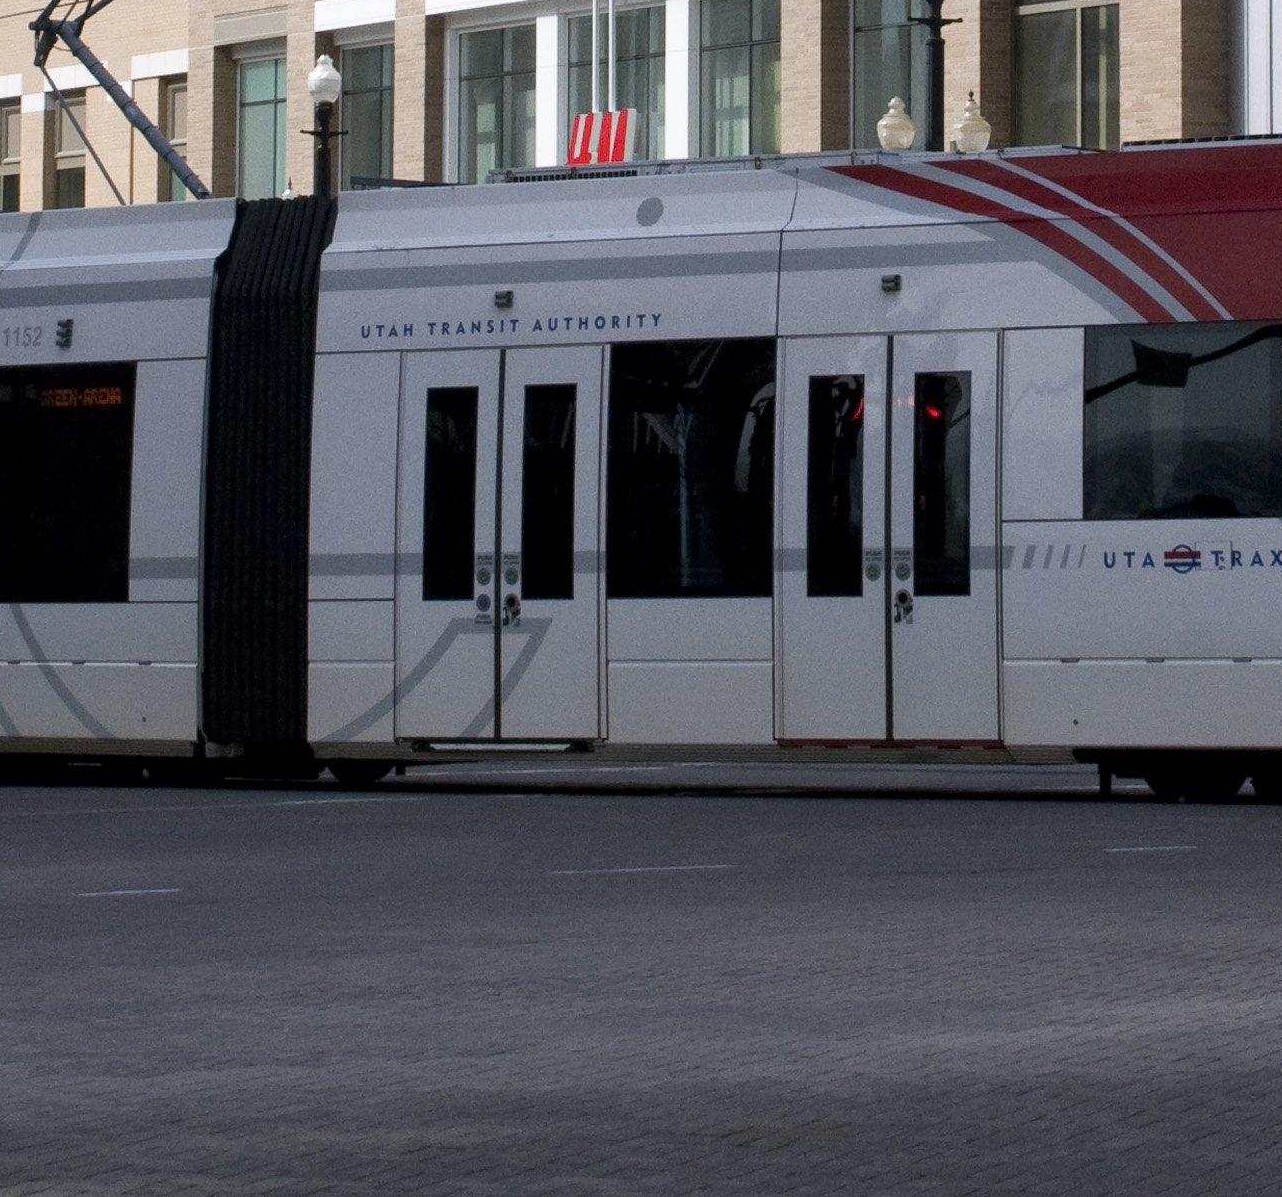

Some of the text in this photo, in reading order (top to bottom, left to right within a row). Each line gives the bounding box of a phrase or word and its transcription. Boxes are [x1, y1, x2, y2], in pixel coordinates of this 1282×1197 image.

[3, 326, 42, 347] 1152
[361, 313, 662, 339] UTAH TRANSIT AUTHORITY
[1103, 551, 1155, 569] UTA
